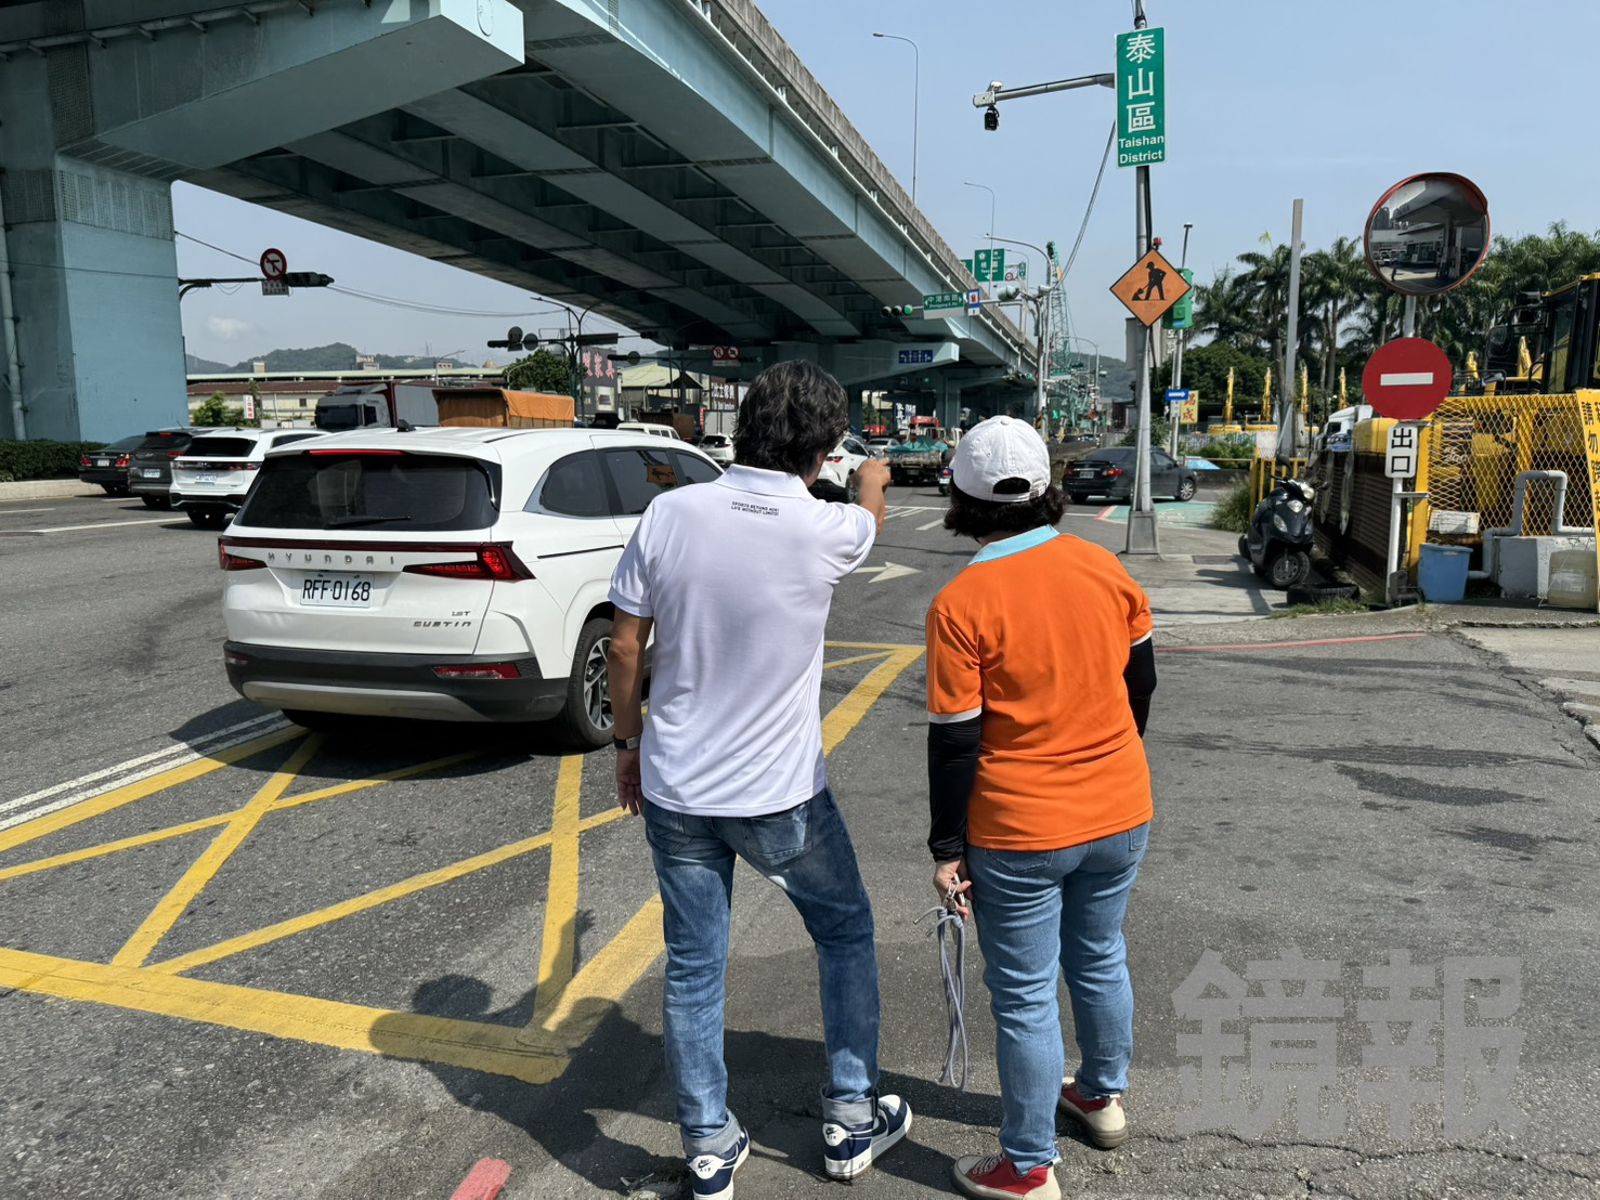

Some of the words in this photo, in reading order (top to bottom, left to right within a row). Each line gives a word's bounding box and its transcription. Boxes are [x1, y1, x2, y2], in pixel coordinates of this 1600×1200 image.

[1126, 33, 1156, 134] 泰山區
[1118, 135, 1165, 149] Taishan
[1119, 150, 1163, 164] District
[1391, 427, 1413, 474] 出口
